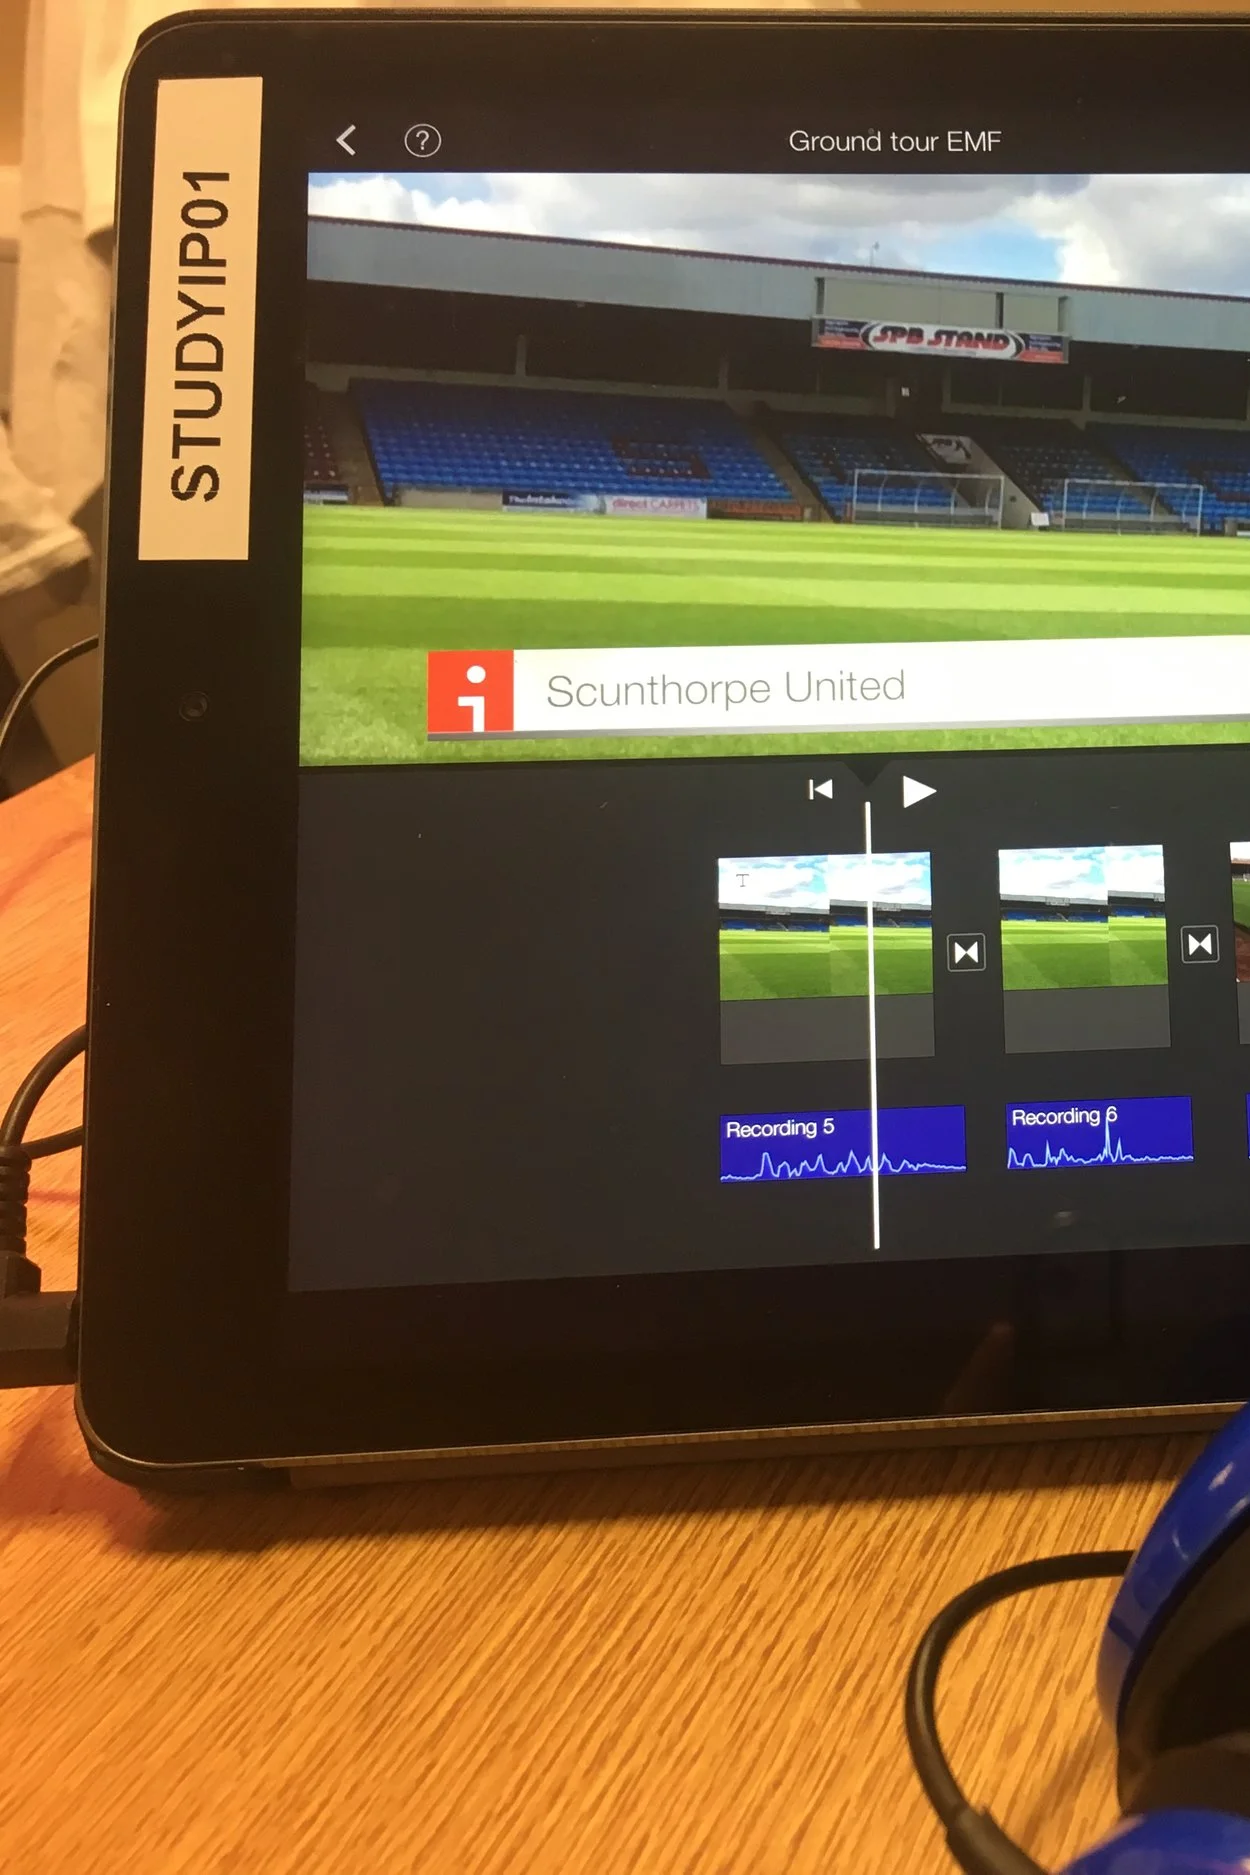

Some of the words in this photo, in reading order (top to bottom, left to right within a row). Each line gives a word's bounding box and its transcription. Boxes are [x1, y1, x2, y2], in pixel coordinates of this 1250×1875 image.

[789, 129, 882, 152] Ground
[890, 131, 939, 152] tour
[947, 130, 1002, 152] EMF
[170, 171, 230, 503] STUDYIP01
[872, 325, 924, 345] SPB
[926, 328, 1010, 351] STAND
[546, 673, 771, 711] Scunthorpe
[785, 669, 907, 701] United
[1012, 1107, 1102, 1126] Recording
[1105, 1105, 1119, 1123] 6
[726, 1118, 819, 1139] Recording
[822, 1117, 836, 1136] 5
